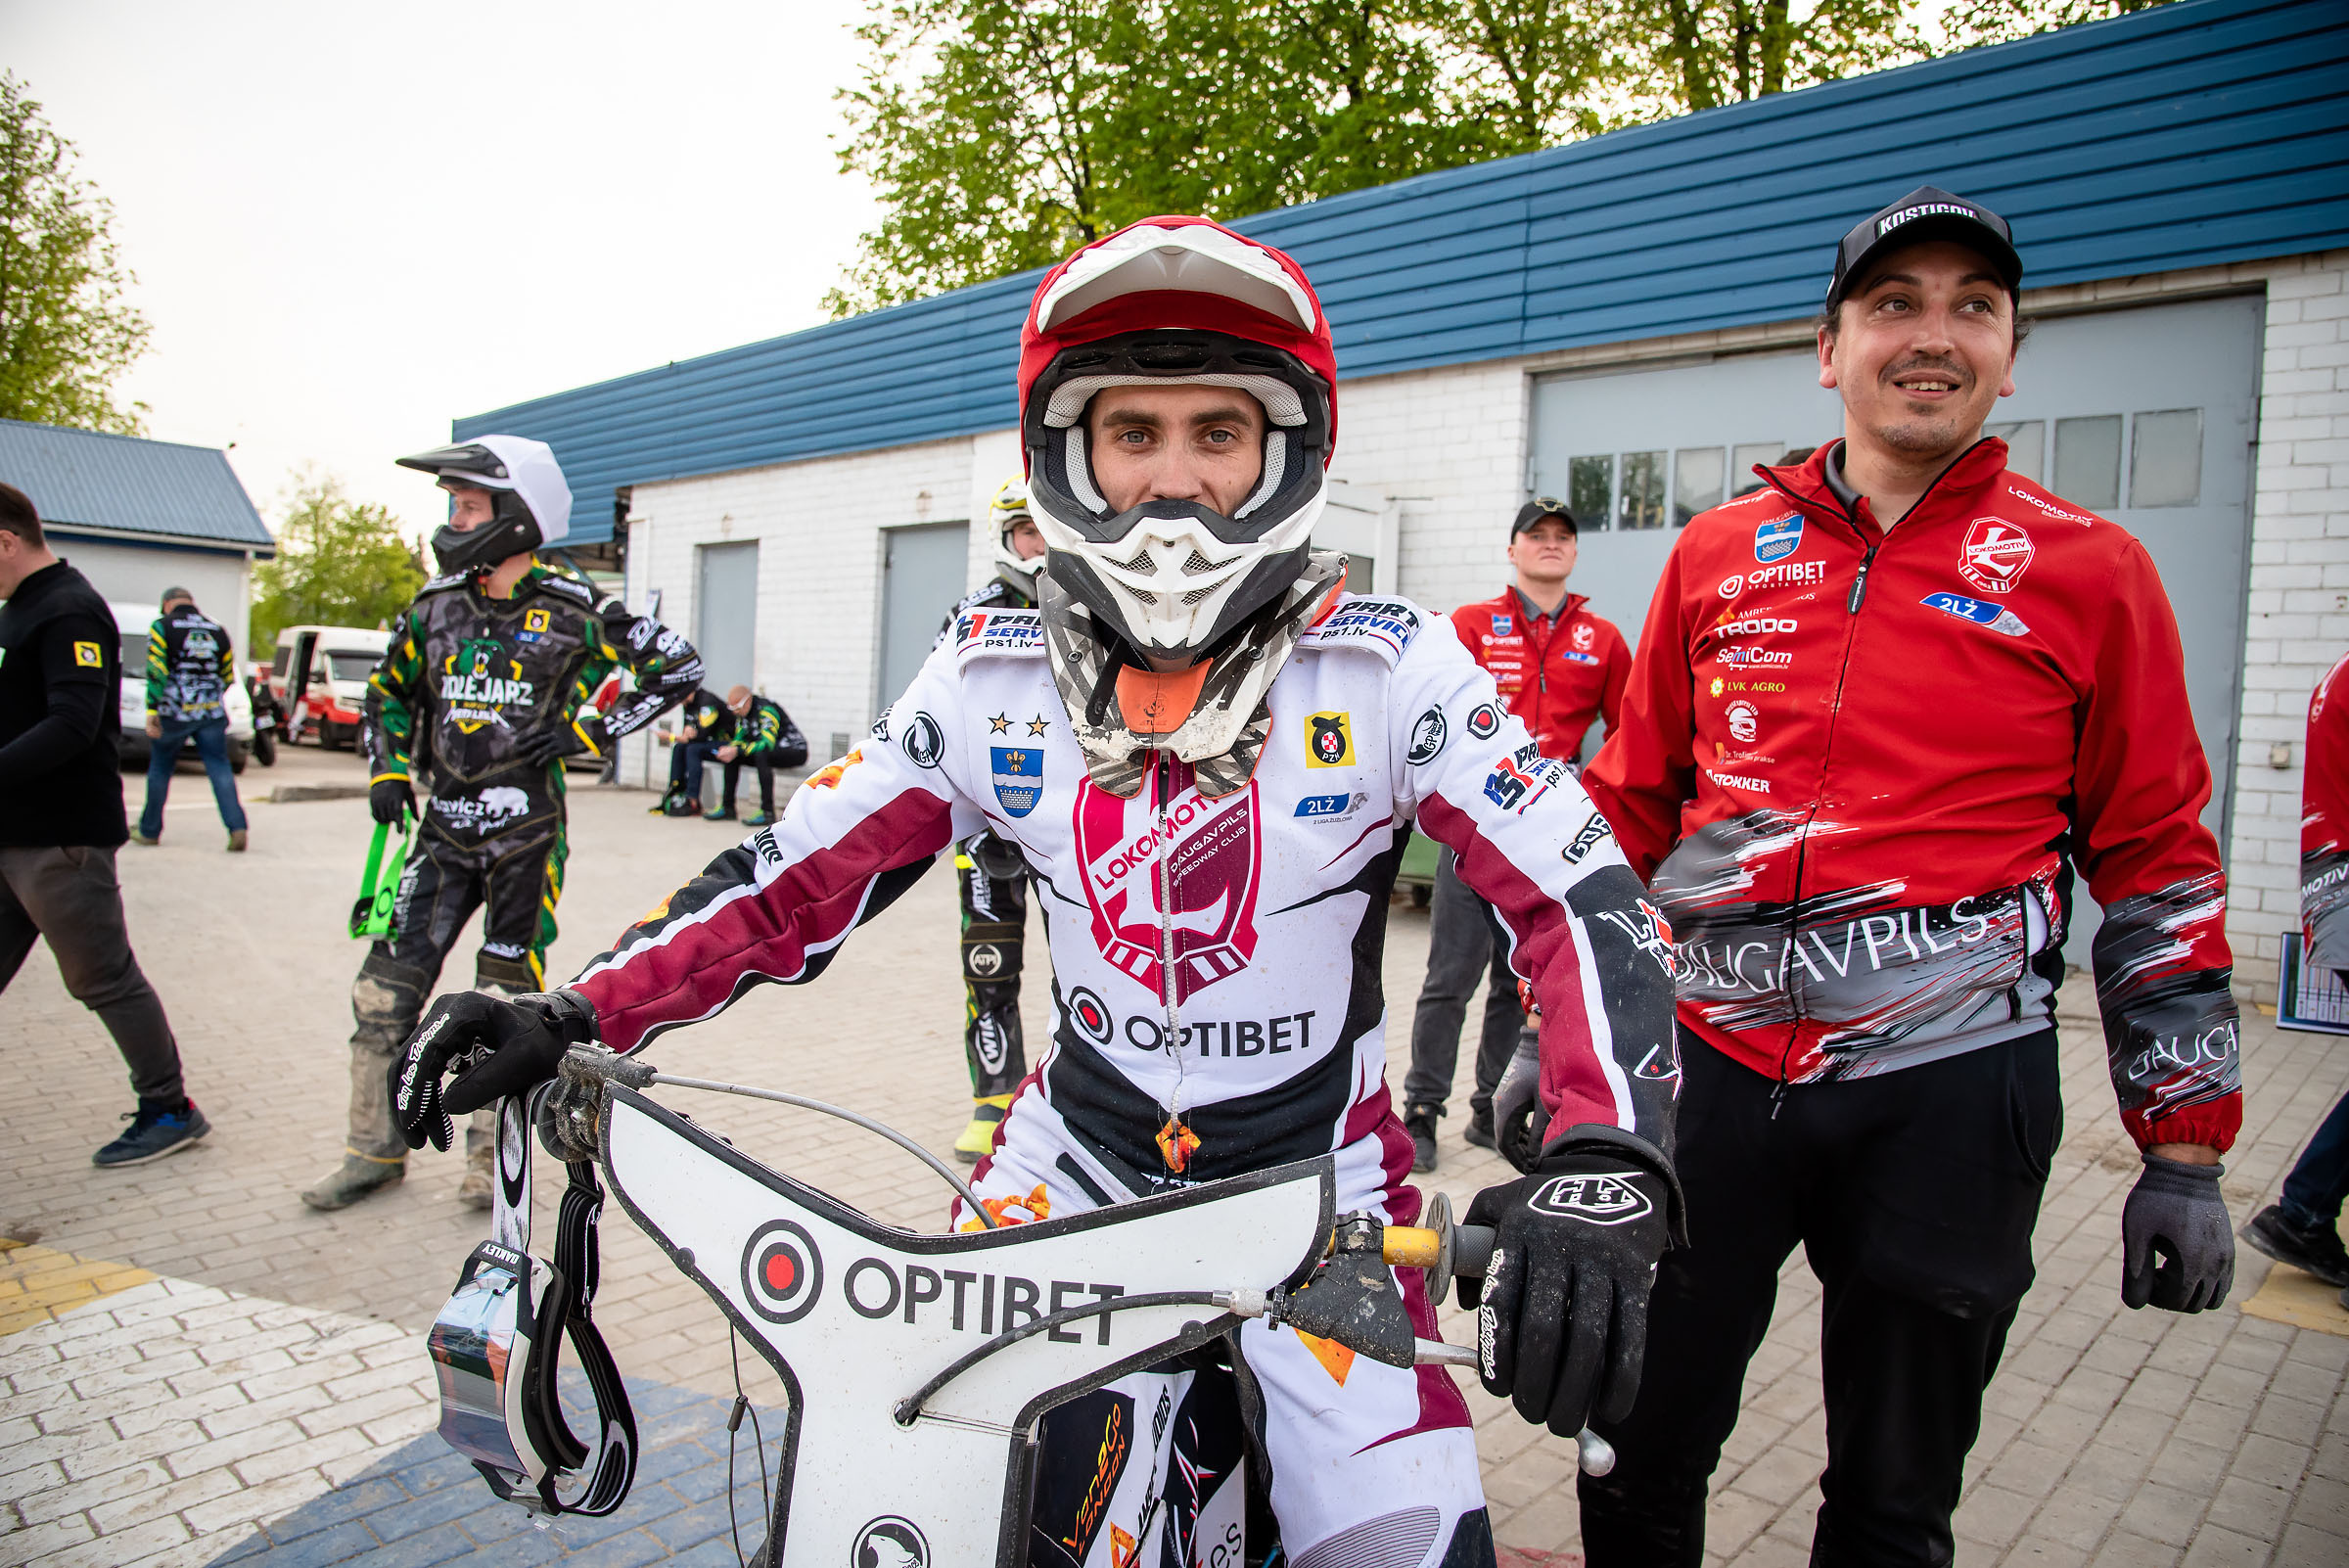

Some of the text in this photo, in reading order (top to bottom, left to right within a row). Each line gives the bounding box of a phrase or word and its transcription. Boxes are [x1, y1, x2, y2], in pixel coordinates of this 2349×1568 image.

[1968, 541, 2026, 554] LOKOMOTIV
[1748, 560, 1826, 584] OPTIBET
[1336, 601, 1420, 628] PART
[1939, 597, 1978, 620] 2LŻ
[1320, 626, 1368, 640] ps1.lv
[1325, 615, 1409, 649] SERVICE
[1715, 619, 1798, 638] TRODO
[985, 639, 1034, 648] ps1.lv
[1727, 682, 1785, 693] LVK AGRO
[1308, 797, 1335, 813] 2LŻ
[1094, 794, 1220, 891] LOKOMOT
[1170, 808, 1248, 874] DAUGAVPILS
[1173, 826, 1247, 888] SPEEDWAY CLUB
[1126, 1010, 1315, 1057] OPTIBET
[397, 1013, 449, 1110] Troy Lee Designs
[482, 1244, 520, 1265] OAKLEY
[1487, 1249, 1504, 1275] Troy
[844, 1257, 1125, 1346] OPTIBET
[1479, 1304, 1498, 1380] Designs
[1079, 1434, 1126, 1556] LONDON
